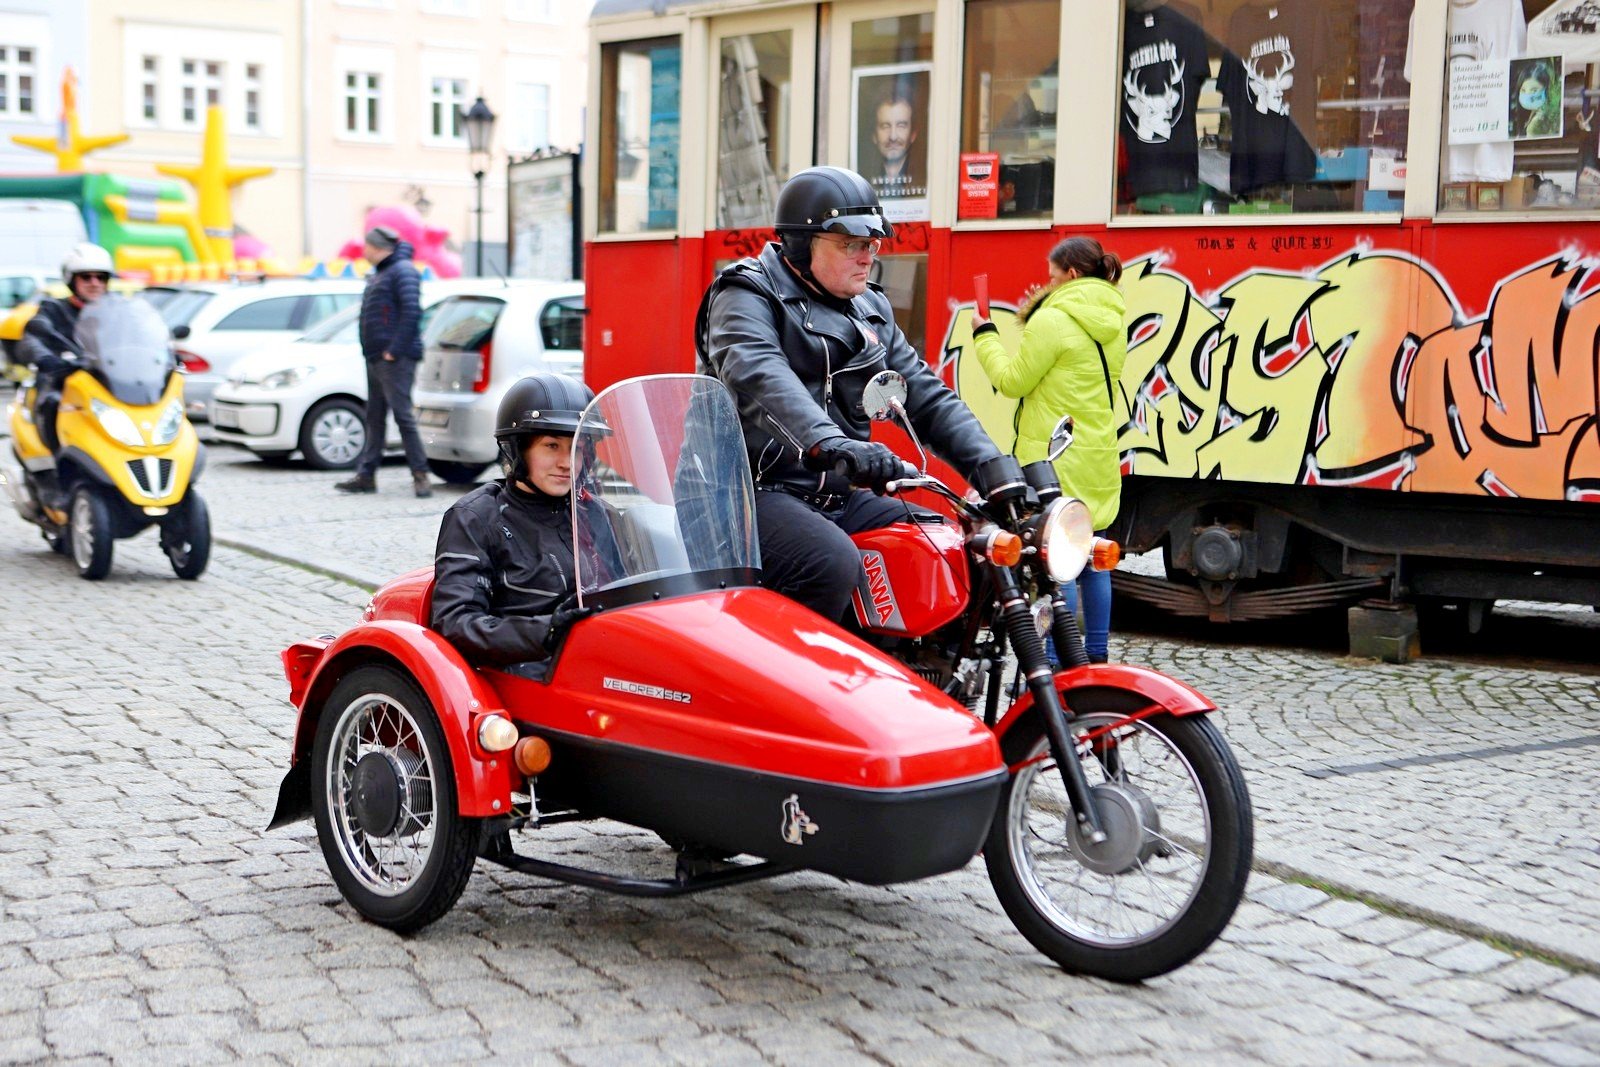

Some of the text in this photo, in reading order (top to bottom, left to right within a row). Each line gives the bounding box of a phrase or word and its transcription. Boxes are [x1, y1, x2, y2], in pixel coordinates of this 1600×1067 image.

[1477, 122, 1489, 131] 10
[1247, 237, 1257, 251] &
[863, 553, 895, 627] JAWA
[604, 679, 691, 704] VELOREX 562
